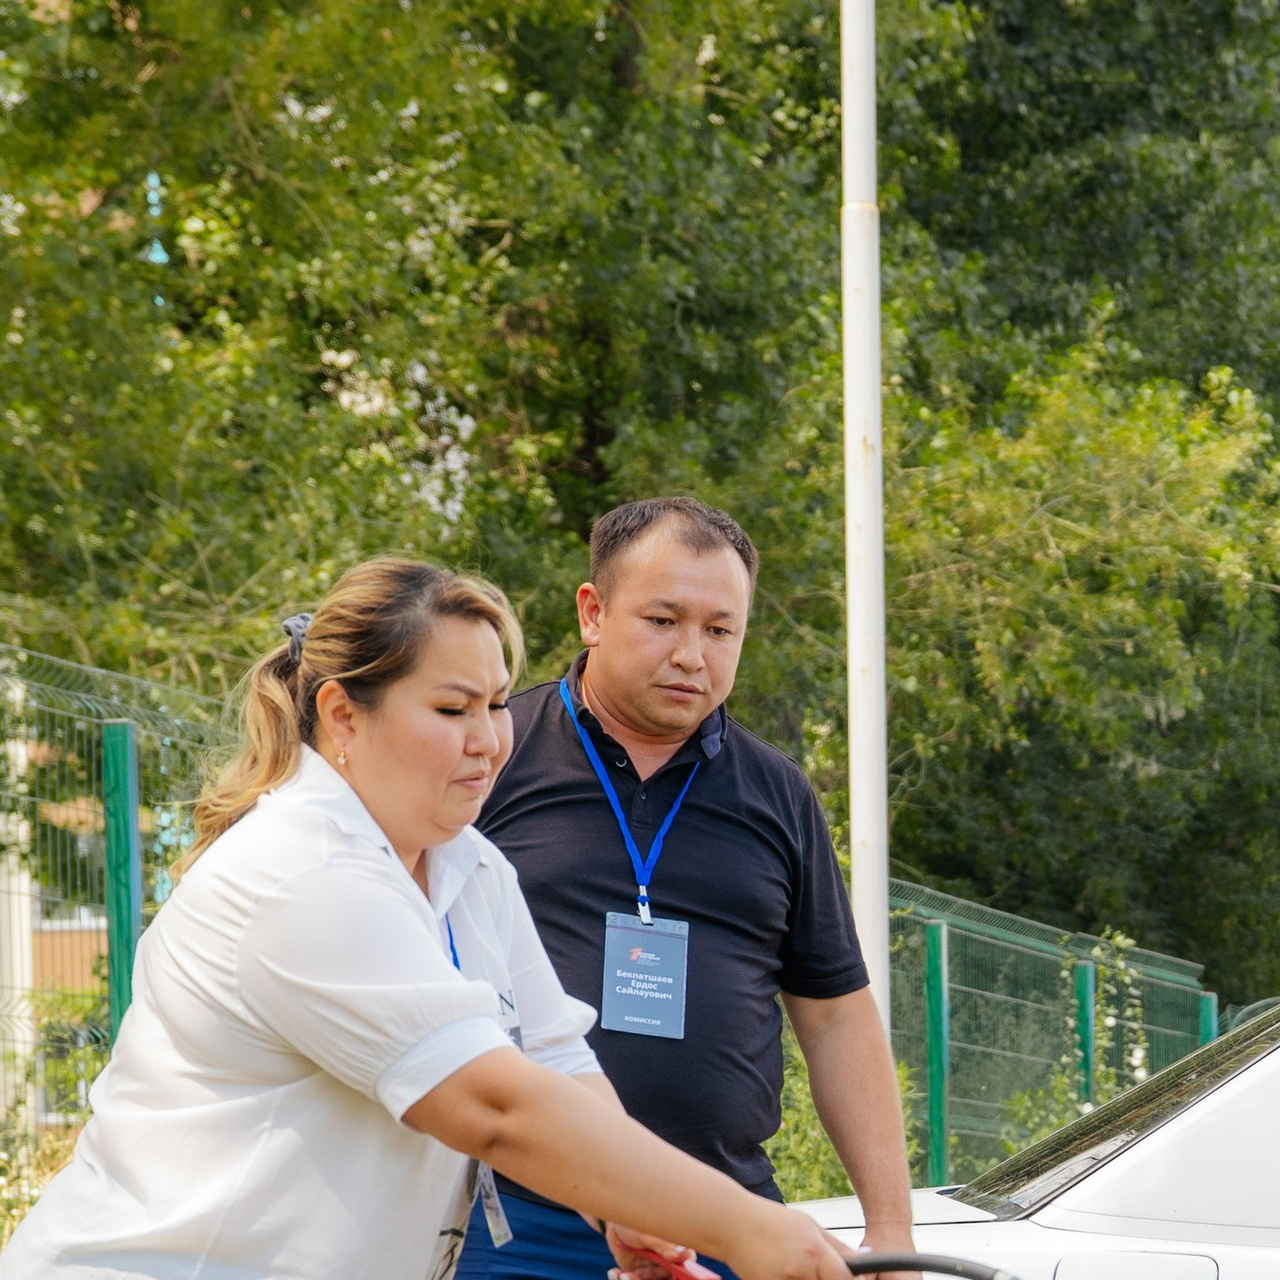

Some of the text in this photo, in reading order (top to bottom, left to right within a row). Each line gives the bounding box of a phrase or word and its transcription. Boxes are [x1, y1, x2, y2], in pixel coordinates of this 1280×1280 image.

[617, 969, 673, 984] Бекпатшаев
[631, 980, 658, 990] Ердос
[616, 986, 672, 1000] Сайлауович
